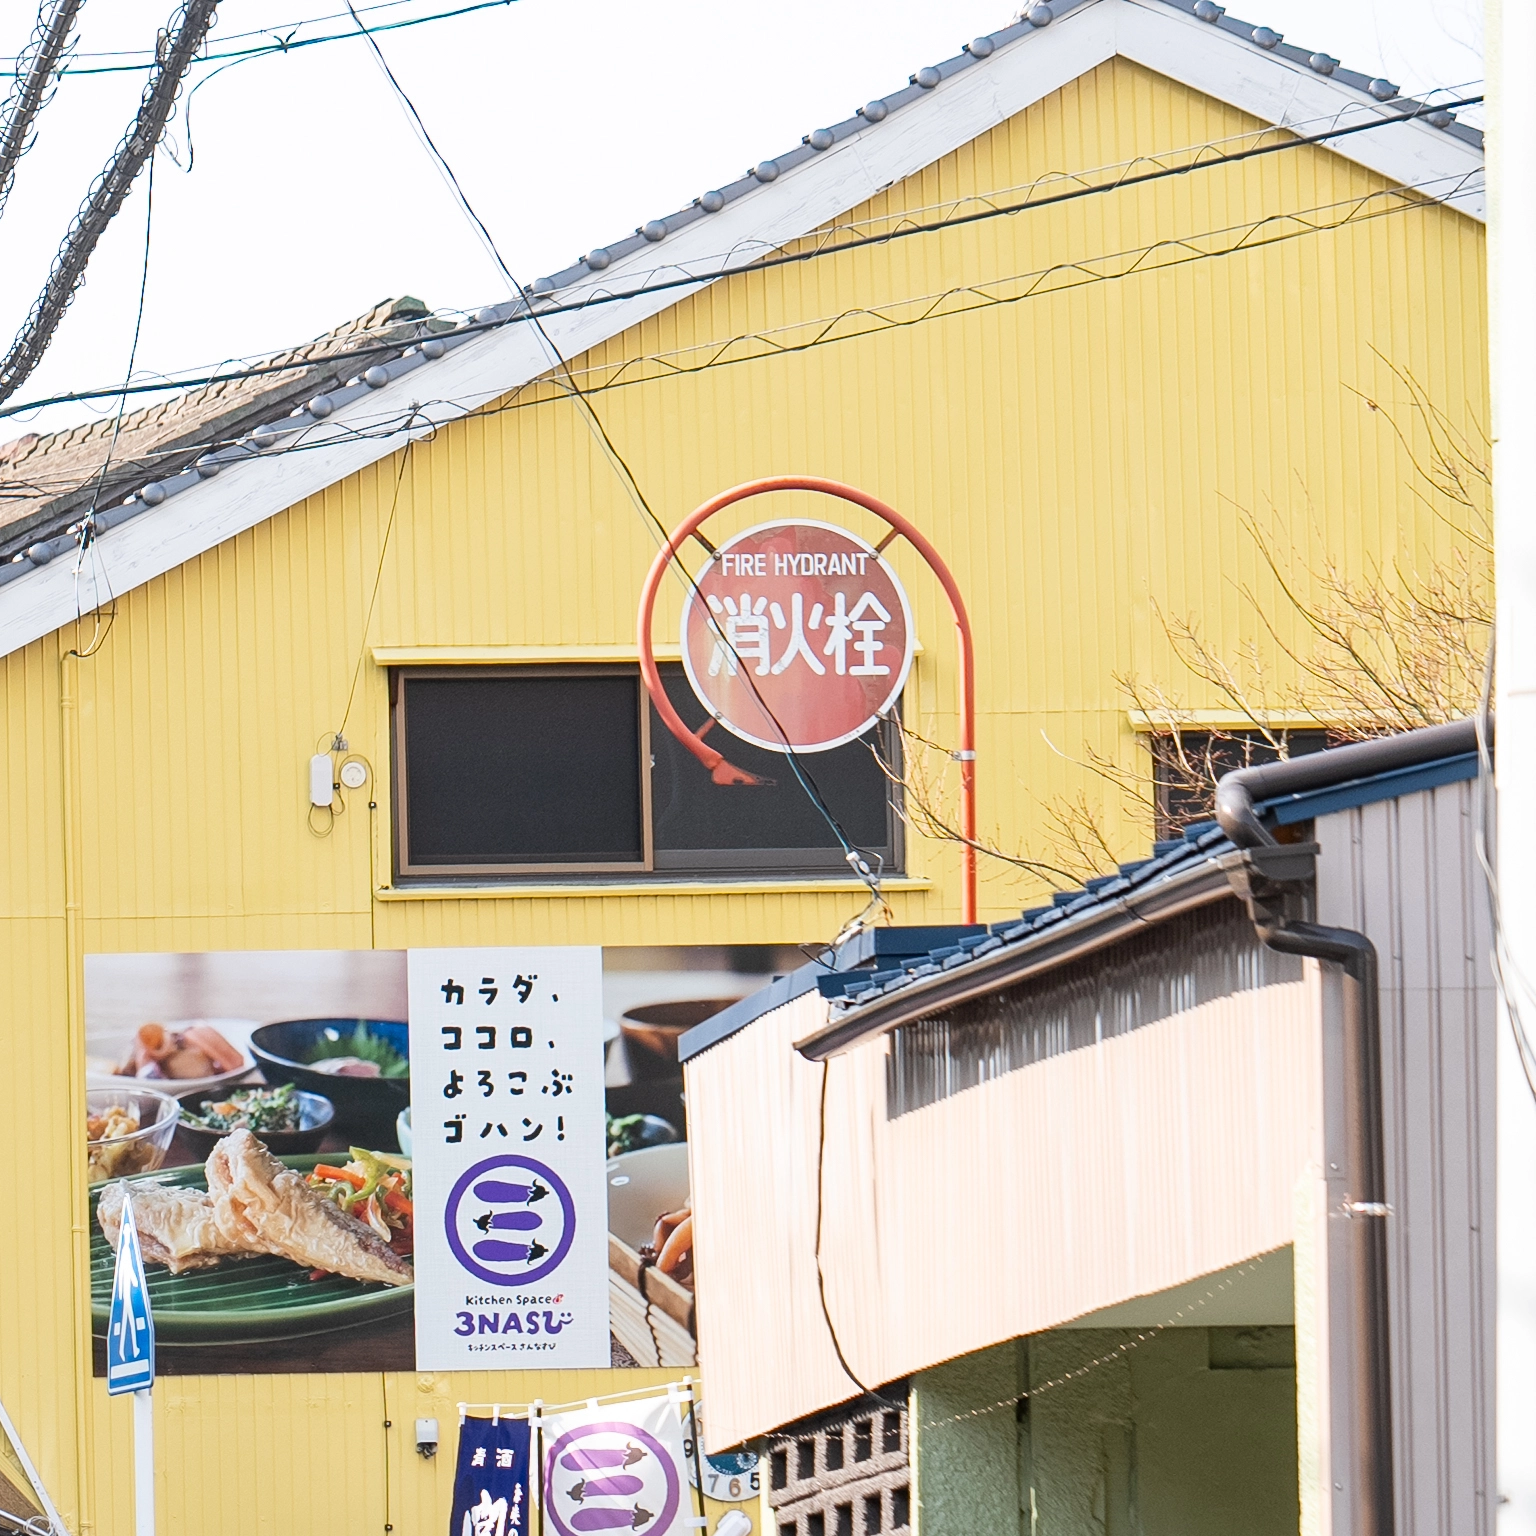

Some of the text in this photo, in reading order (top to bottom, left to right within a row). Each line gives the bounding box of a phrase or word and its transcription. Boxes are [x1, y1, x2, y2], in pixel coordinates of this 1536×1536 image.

[722, 552, 869, 577] FIRE HYDRANT
[706, 591, 891, 677] 消火栓
[441, 974, 559, 1006] カラダ、
[441, 1026, 555, 1051] ココロ、
[443, 1069, 573, 1099] よろこぶ
[516, 1294, 552, 1306] Space
